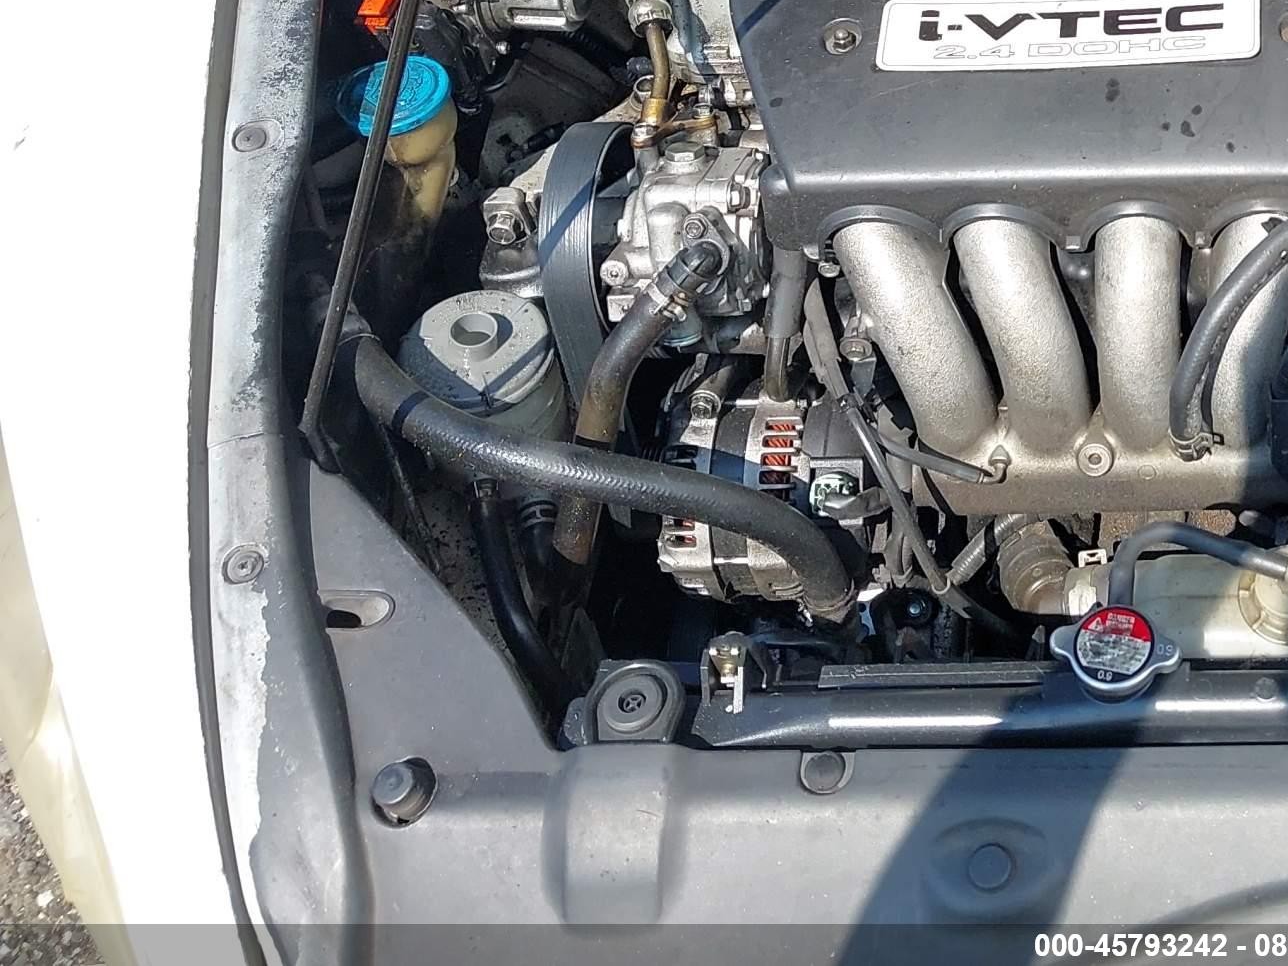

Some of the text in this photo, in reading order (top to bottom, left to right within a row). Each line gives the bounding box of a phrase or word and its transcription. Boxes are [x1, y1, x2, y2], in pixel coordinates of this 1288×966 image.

[918, 3, 1224, 42] i-VTEC
[933, 35, 1206, 60] 2.4 DOHC
[1096, 669, 1113, 682] 0.9
